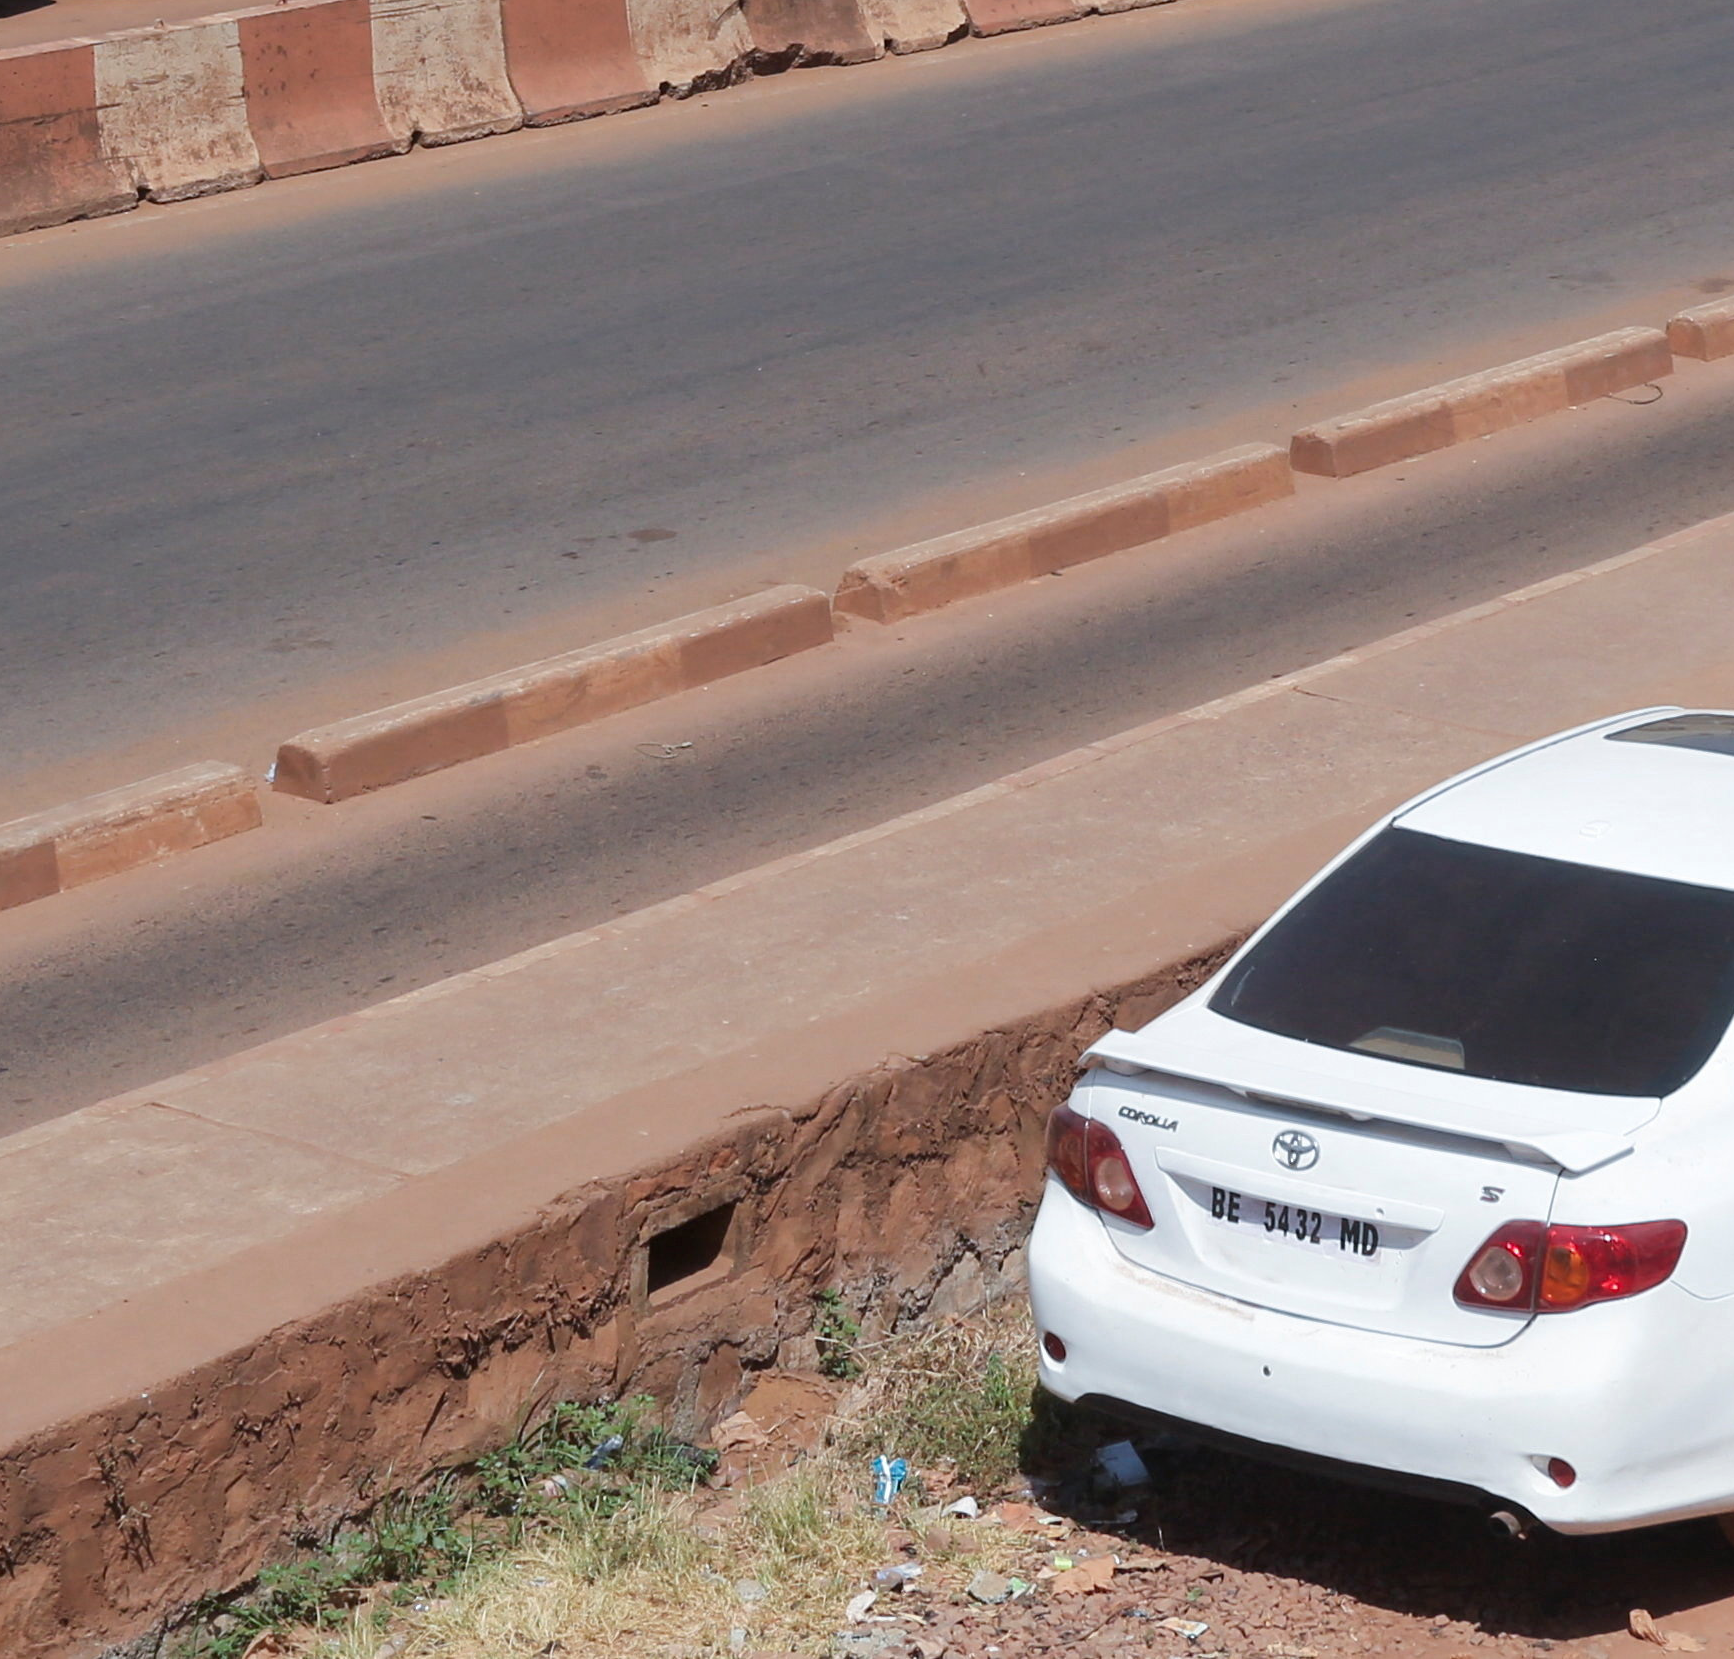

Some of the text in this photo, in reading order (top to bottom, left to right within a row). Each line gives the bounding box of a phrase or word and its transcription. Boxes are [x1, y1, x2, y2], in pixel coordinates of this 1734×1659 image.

[1118, 1106, 1179, 1133] COROLLA
[1480, 1186, 1506, 1203] S
[1211, 1186, 1379, 1257] BE 5432 MD
